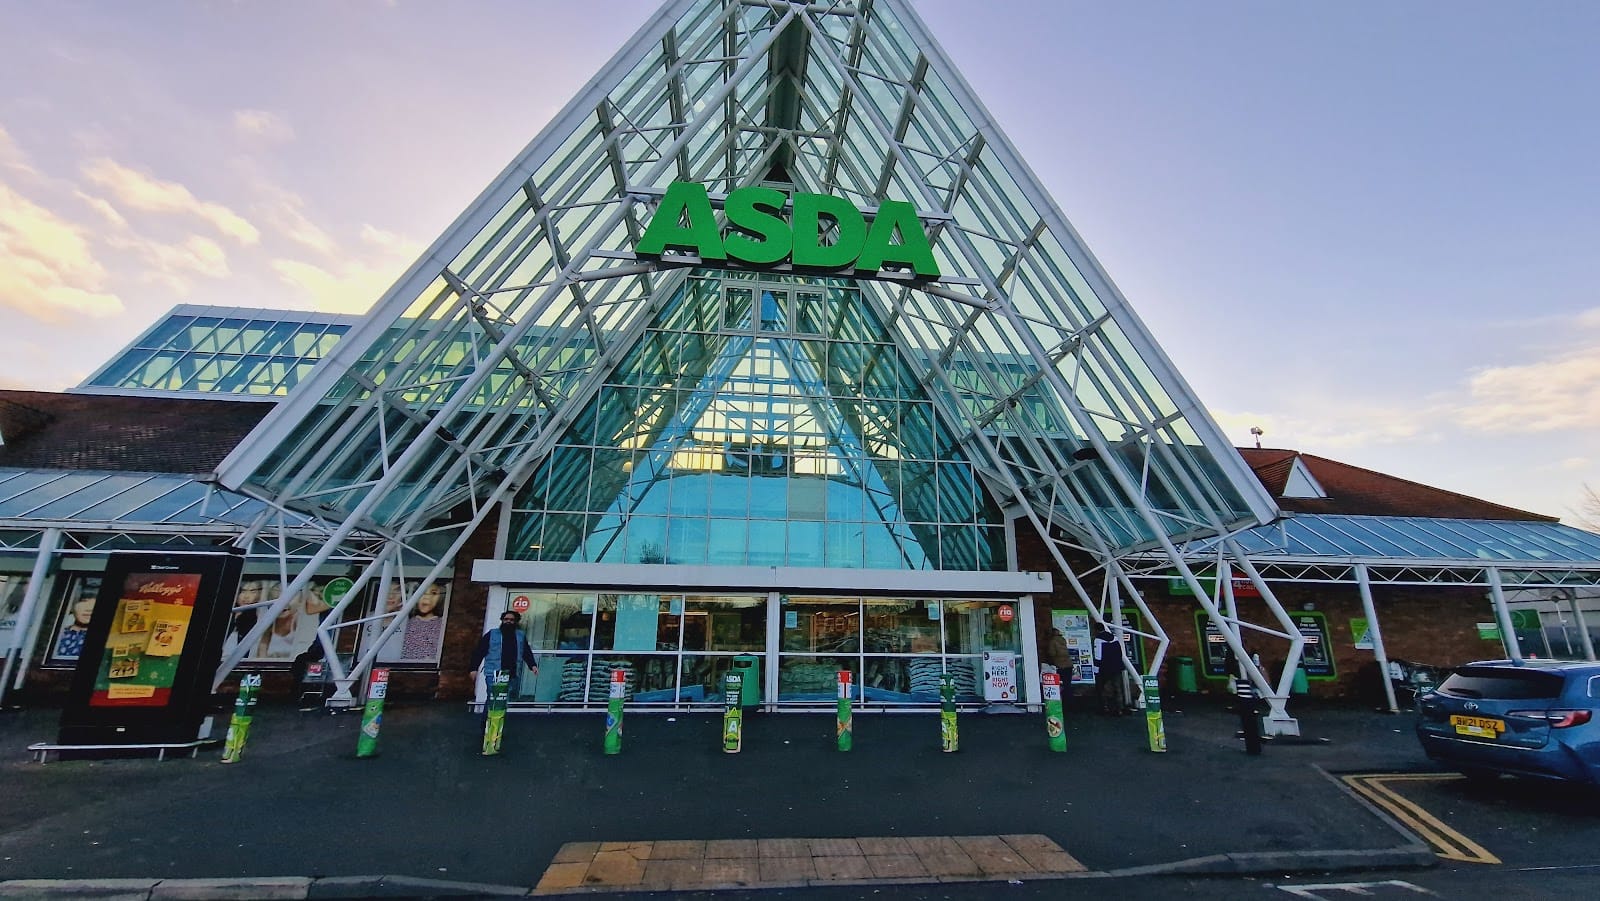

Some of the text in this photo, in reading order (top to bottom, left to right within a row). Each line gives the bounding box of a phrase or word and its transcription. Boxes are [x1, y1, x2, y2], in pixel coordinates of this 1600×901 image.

[635, 181, 940, 280] ASDA
[514, 597, 528, 607] ria
[1000, 607, 1012, 615] ria
[726, 675, 742, 683] ASDA
